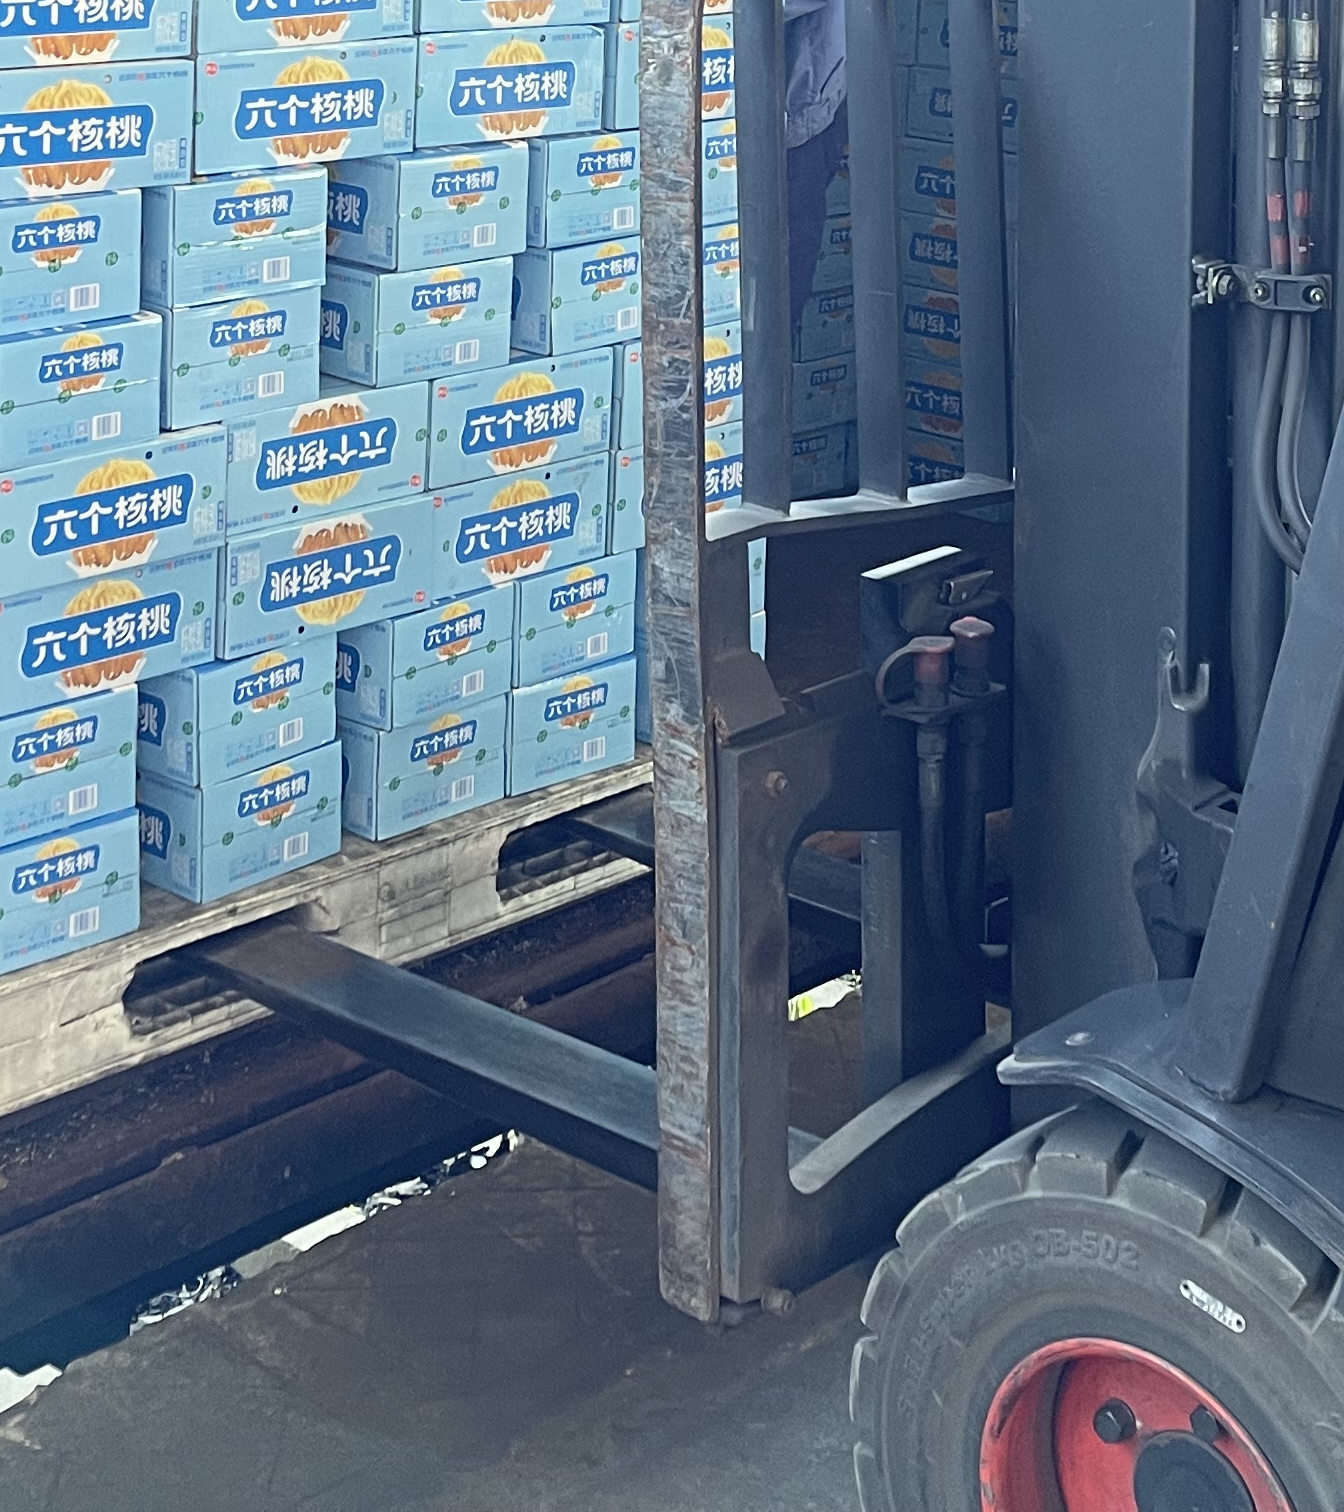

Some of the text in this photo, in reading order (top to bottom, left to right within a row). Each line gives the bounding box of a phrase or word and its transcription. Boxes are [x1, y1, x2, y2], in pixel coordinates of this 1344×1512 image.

[458, 70, 568, 108] 六个核桃
[245, 89, 375, 130] 六个核桃
[578, 151, 634, 175] 六个核桃
[706, 138, 736, 159] 六个
[434, 170, 496, 194] 六个核桃
[920, 171, 955, 194] 六个
[218, 195, 290, 221] 六个核桃
[16, 220, 96, 248] 六个核桃
[583, 256, 637, 281] 六个核桃
[415, 282, 477, 307] 六个核桃
[214, 315, 283, 343] 六个核桃
[44, 348, 119, 379] 六个核桃
[907, 388, 960, 414] 六个核
[469, 396, 579, 446] 六个核桃
[265, 425, 388, 481] 六个核桃
[705, 461, 743, 496] 核桃
[42, 484, 183, 547] 六个核桃
[464, 499, 574, 555] 六个核桃
[270, 544, 392, 602] 六个核桃
[553, 579, 606, 607] 六个核桃
[32, 604, 172, 668] 六个核桃
[427, 613, 483, 647] 六个核桃
[236, 662, 302, 702] 六个核桃
[548, 688, 605, 717] 六个核桃
[17, 720, 94, 755] 六个核桃
[414, 724, 475, 758] 六个核桃
[242, 774, 307, 811] 六个核桃
[17, 849, 96, 886] 六个核桃
